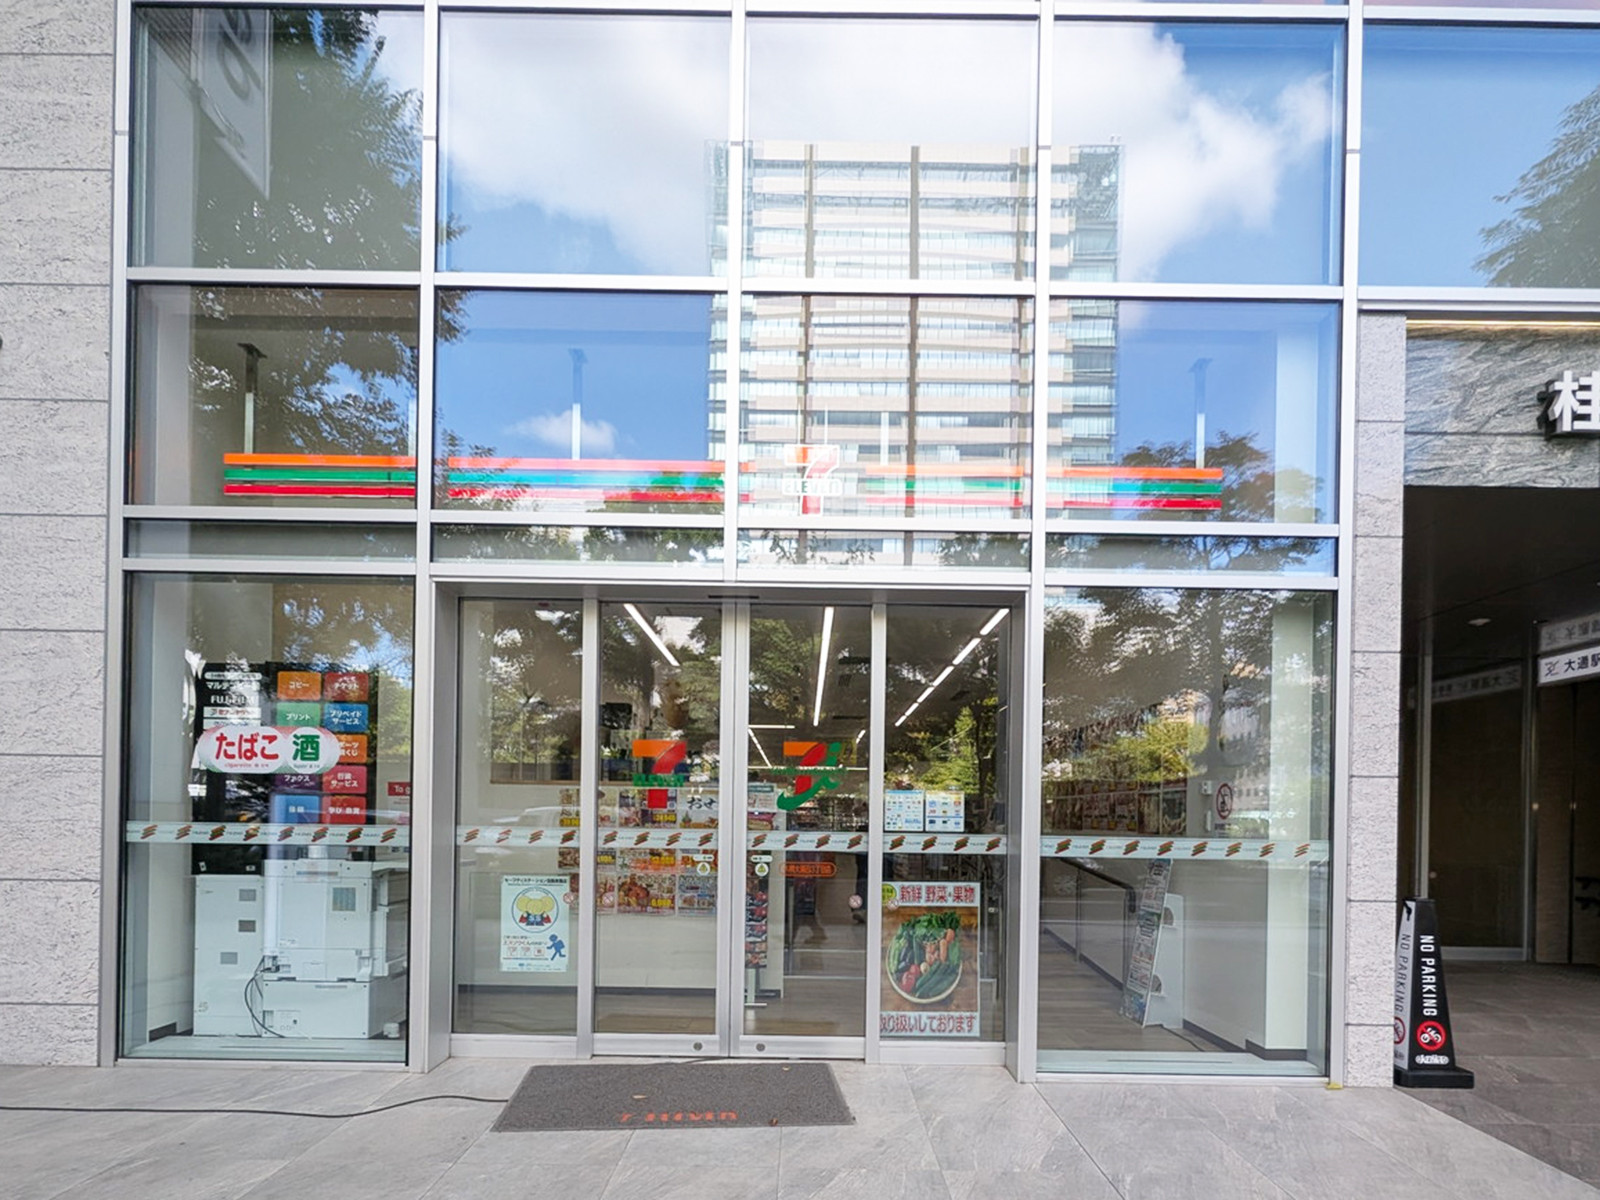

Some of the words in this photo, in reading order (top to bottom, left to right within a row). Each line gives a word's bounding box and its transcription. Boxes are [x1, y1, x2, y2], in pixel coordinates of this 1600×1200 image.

[289, 681, 309, 689] コピー
[215, 732, 279, 760] たばこ
[292, 733, 320, 761] 酒
[1400, 933, 1411, 951] NO
[1419, 935, 1435, 952] NO
[1421, 957, 1438, 1017] PARKING
